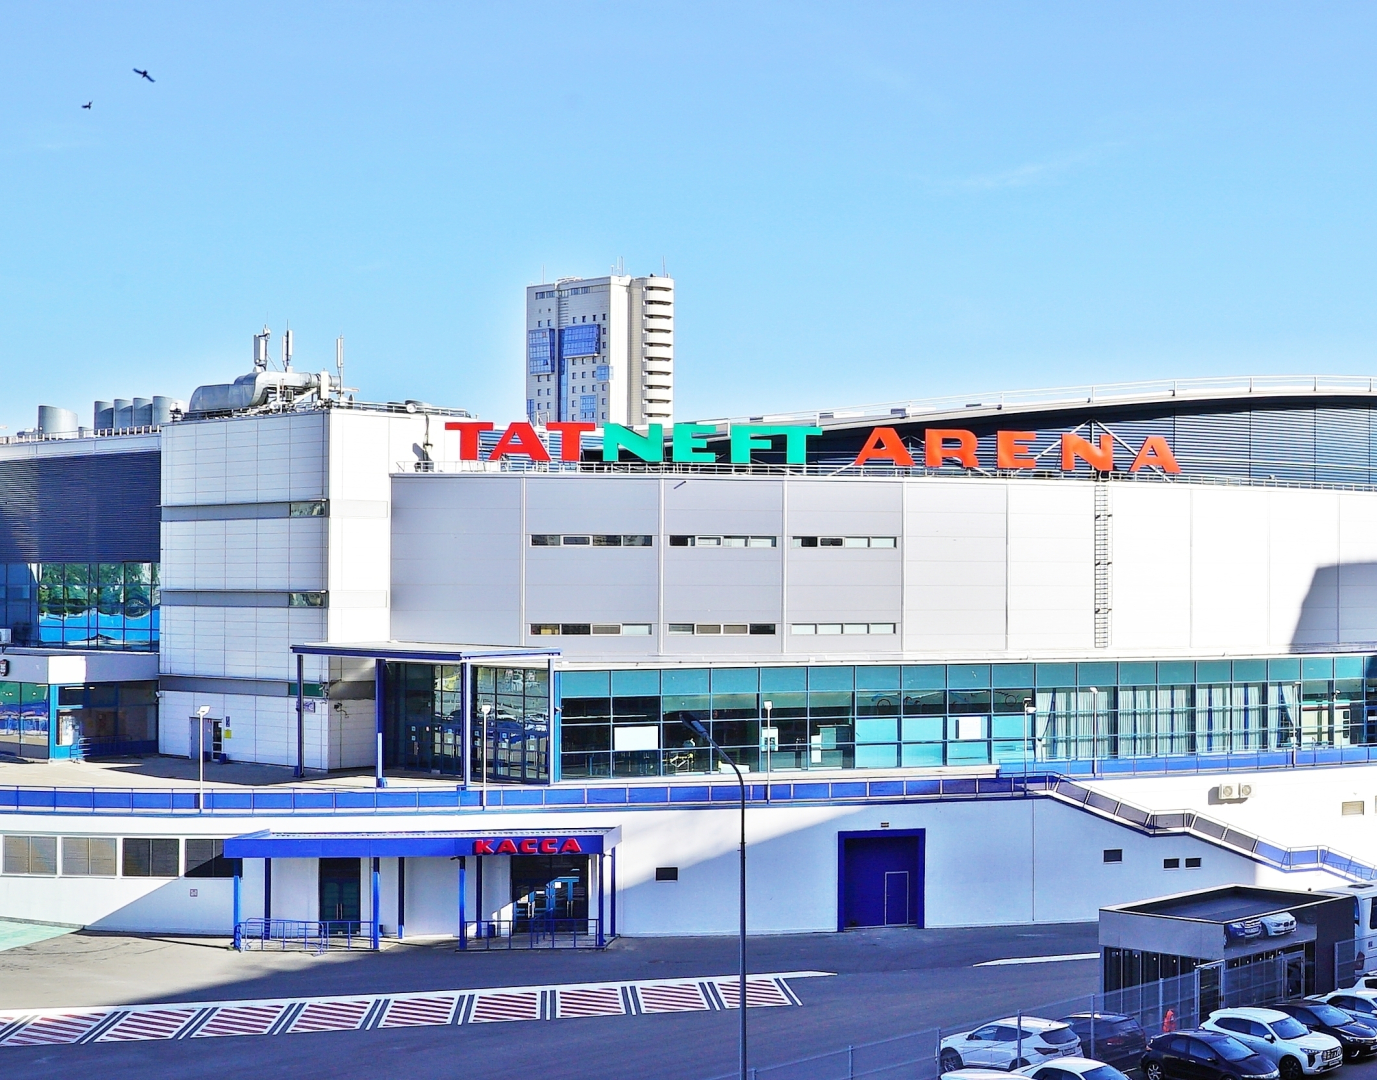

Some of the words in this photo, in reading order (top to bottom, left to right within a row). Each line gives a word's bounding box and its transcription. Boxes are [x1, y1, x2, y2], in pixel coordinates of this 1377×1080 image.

[445, 421, 823, 464] TATNEFT
[853, 426, 1182, 474] ARENA
[474, 838, 582, 854] КАССА
